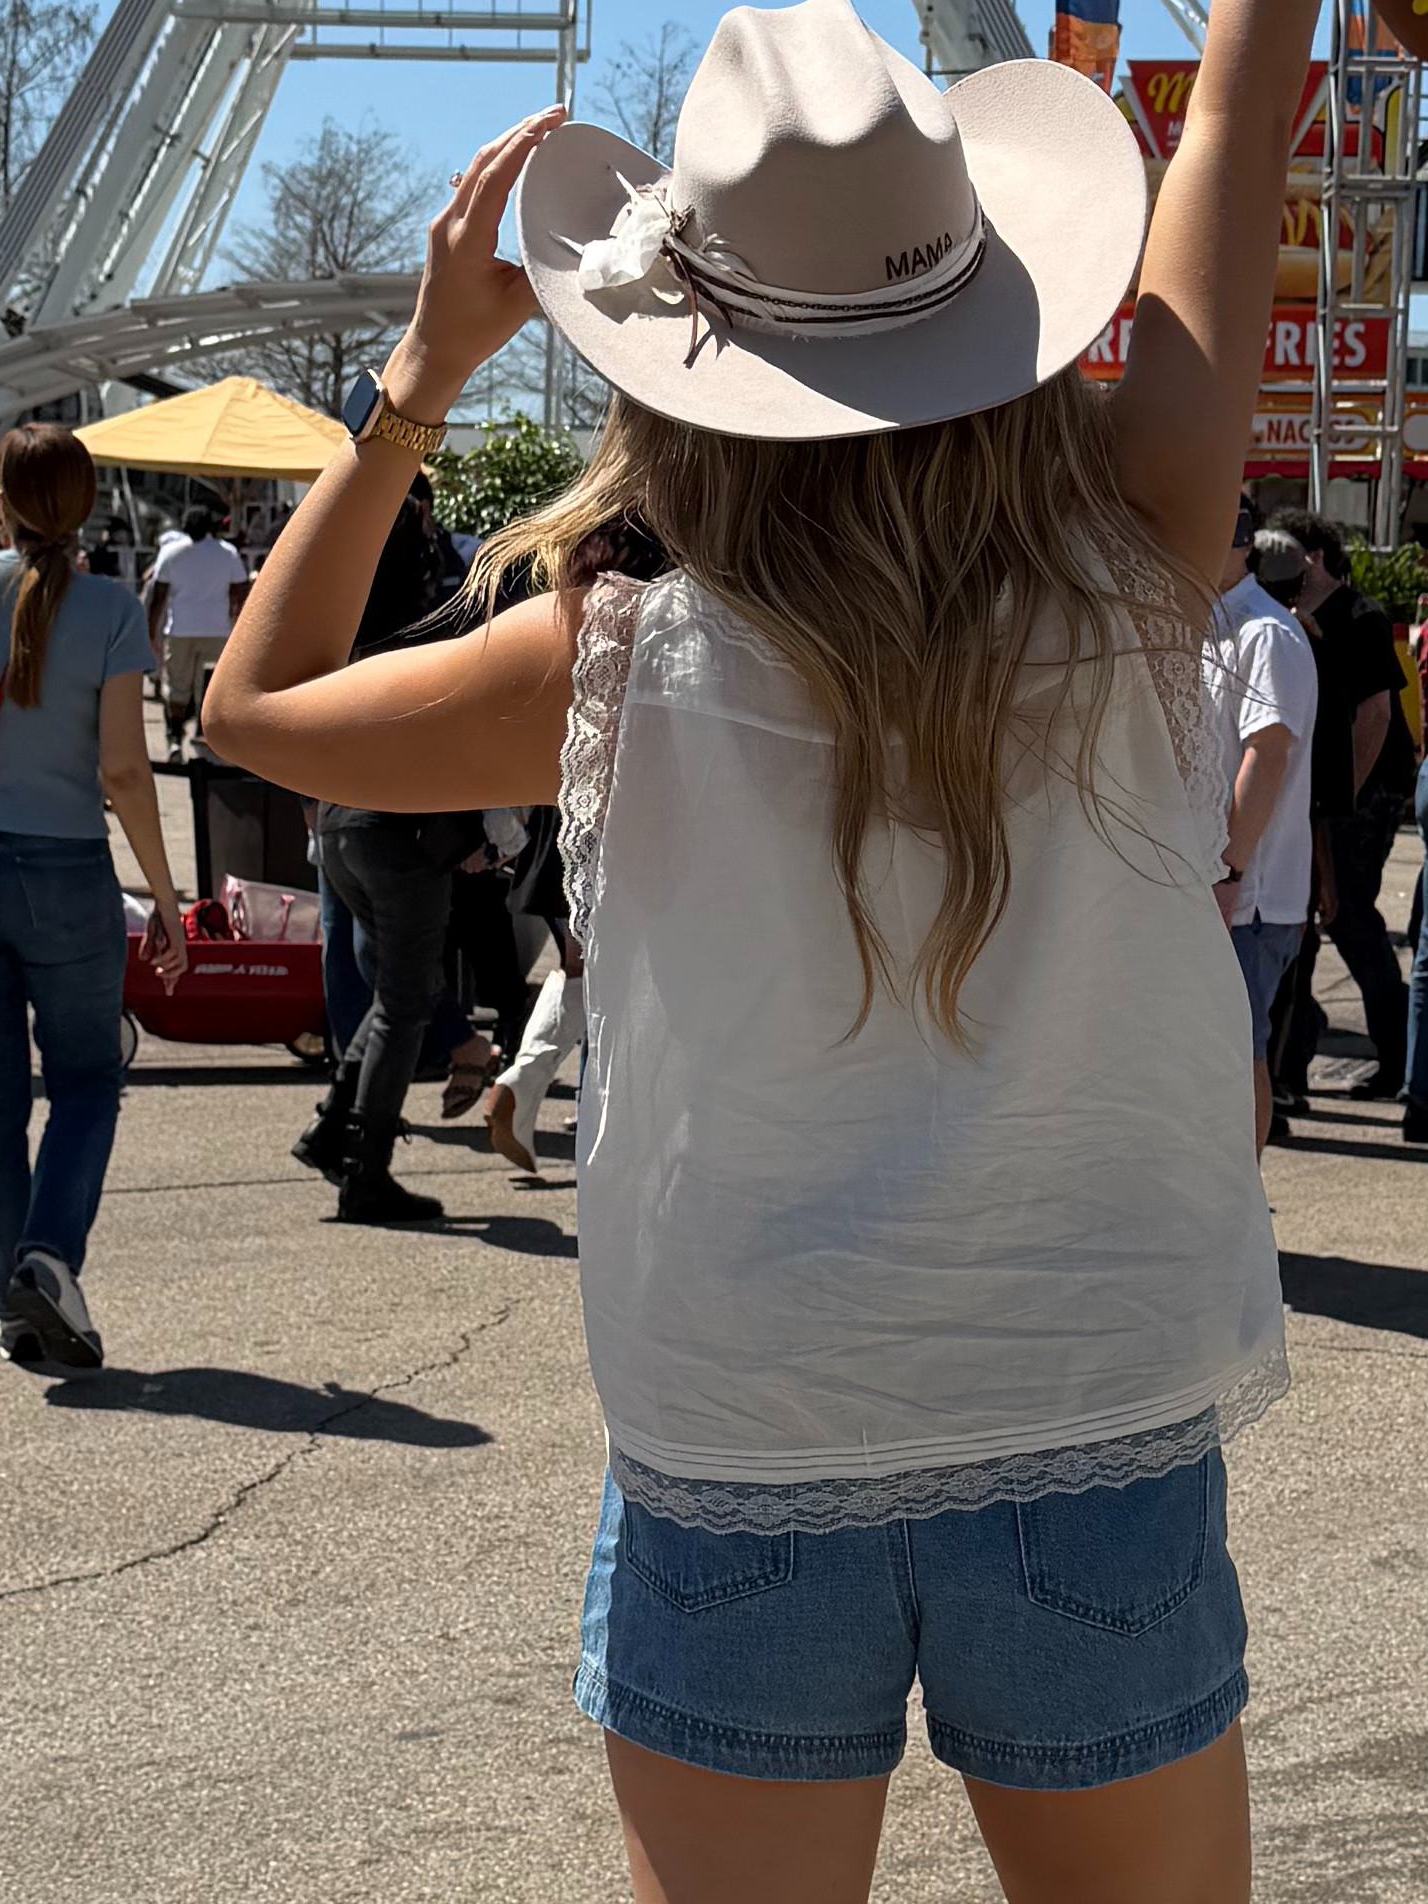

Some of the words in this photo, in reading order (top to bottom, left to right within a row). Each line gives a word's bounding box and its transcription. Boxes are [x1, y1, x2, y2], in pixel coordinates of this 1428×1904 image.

[885, 231, 954, 281] MAMA
[1266, 320, 1367, 368] RIS
[1267, 419, 1356, 445] NACOS
